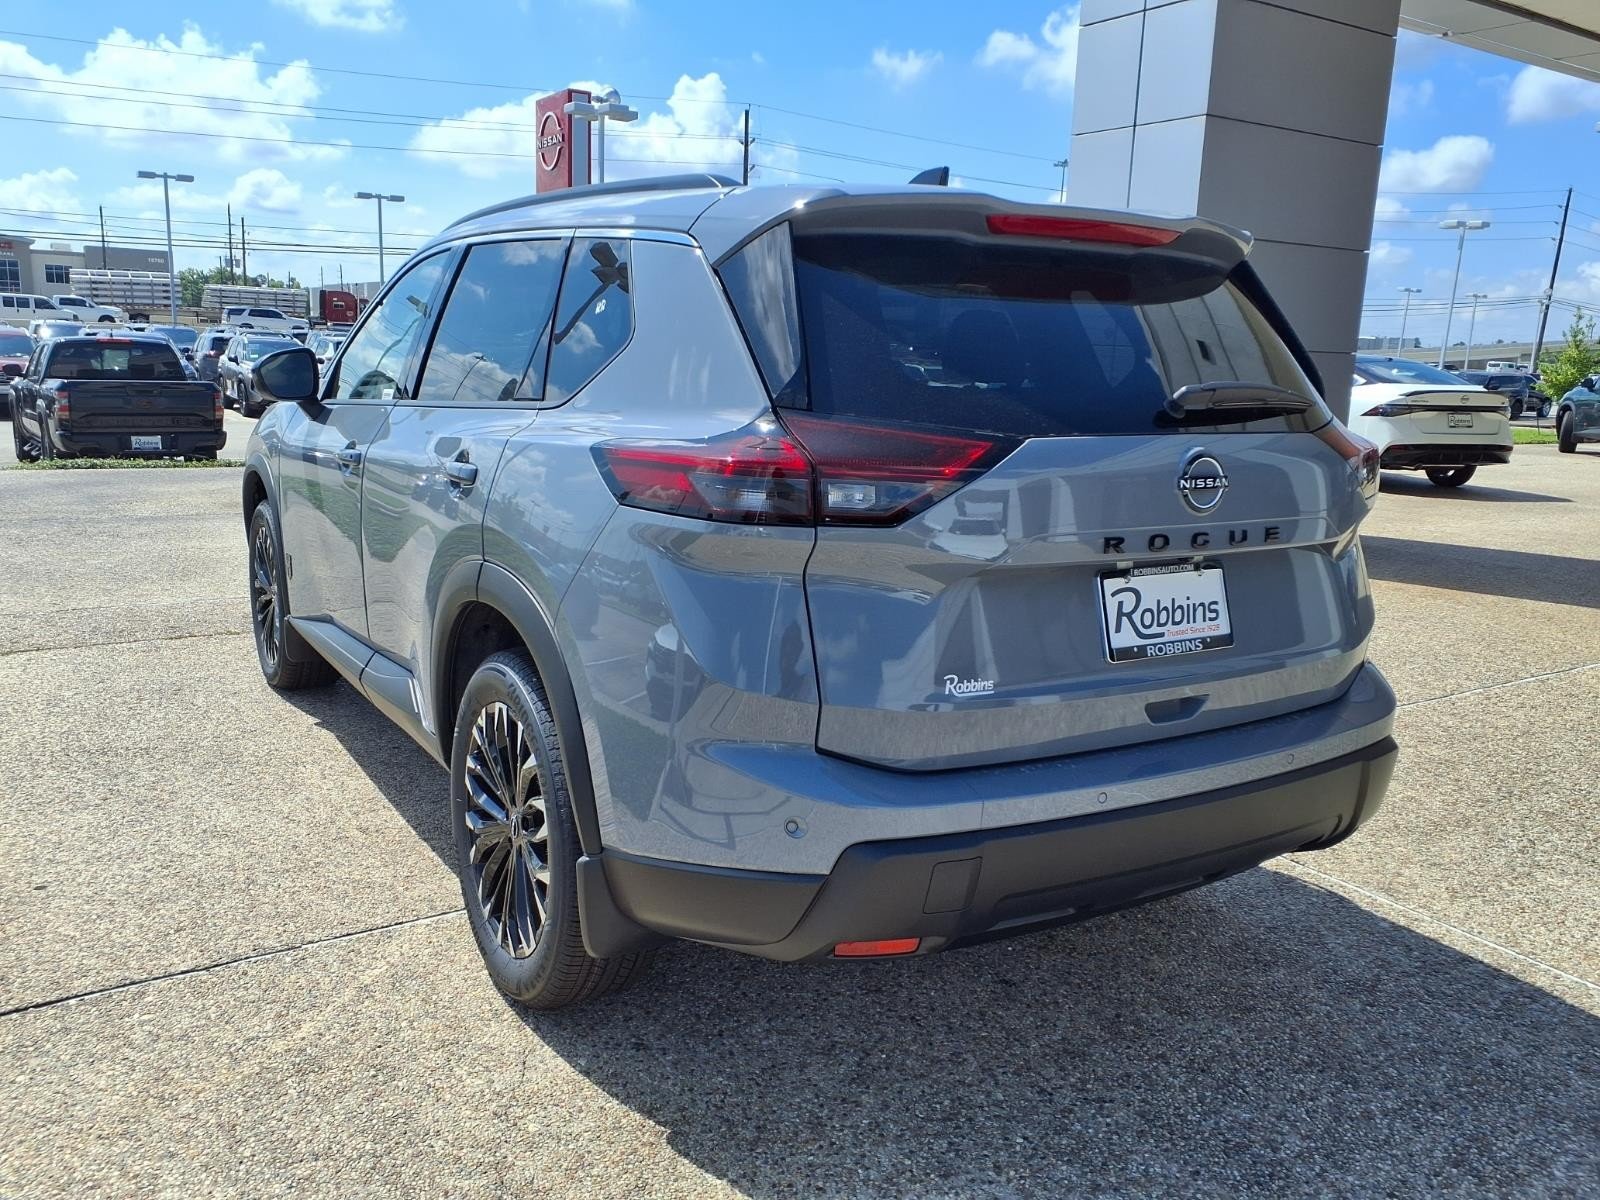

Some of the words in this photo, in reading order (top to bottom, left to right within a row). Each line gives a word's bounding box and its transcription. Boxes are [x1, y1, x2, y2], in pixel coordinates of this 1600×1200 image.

[537, 134, 563, 149] NISSAN
[1180, 478, 1229, 489] NISSAN
[1103, 527, 1280, 554] ROGUE
[1110, 586, 1219, 640] Robbins
[1167, 627, 1188, 637] Trusted
[1190, 626, 1205, 634] Since
[1147, 639, 1203, 656] ROBBINS
[943, 674, 995, 697] Robbins
